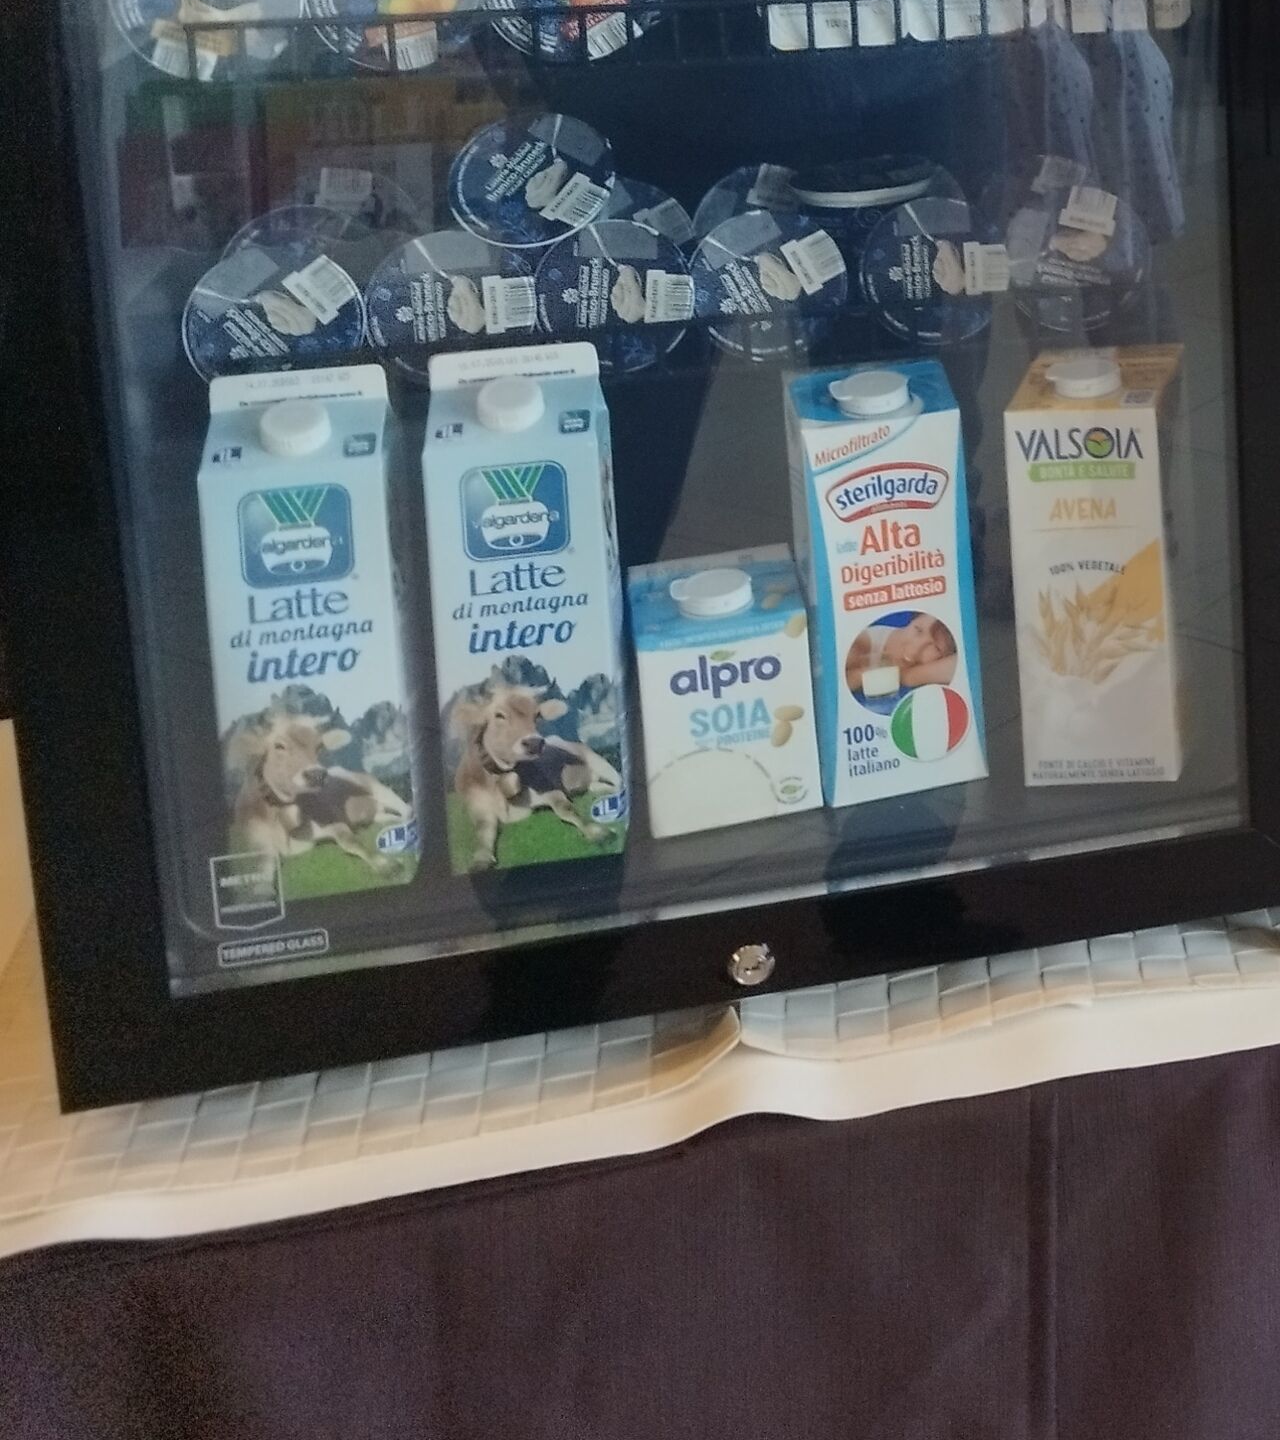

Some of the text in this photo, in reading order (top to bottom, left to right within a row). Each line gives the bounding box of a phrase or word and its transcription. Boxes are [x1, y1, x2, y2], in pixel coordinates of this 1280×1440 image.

[814, 425, 891, 466] Microfiltrato
[1015, 427, 1144, 461] VALSOIA
[836, 472, 938, 510] sterilgarda
[1050, 498, 1117, 521] AVENA
[860, 518, 921, 555] Alta
[469, 562, 566, 597] Latte
[841, 549, 945, 586] Digeribilità
[247, 587, 349, 624] Latte
[453, 592, 588, 620] di montagna
[848, 578, 943, 608] senza lattosio
[230, 617, 373, 649] di montagna
[469, 620, 576, 654] intero
[248, 646, 359, 683] intero
[670, 655, 781, 699] alpro
[690, 697, 772, 738] SOIA
[848, 746, 878, 762] latte
[849, 758, 900, 778] italiano
[287, 934, 324, 951] GLASS
